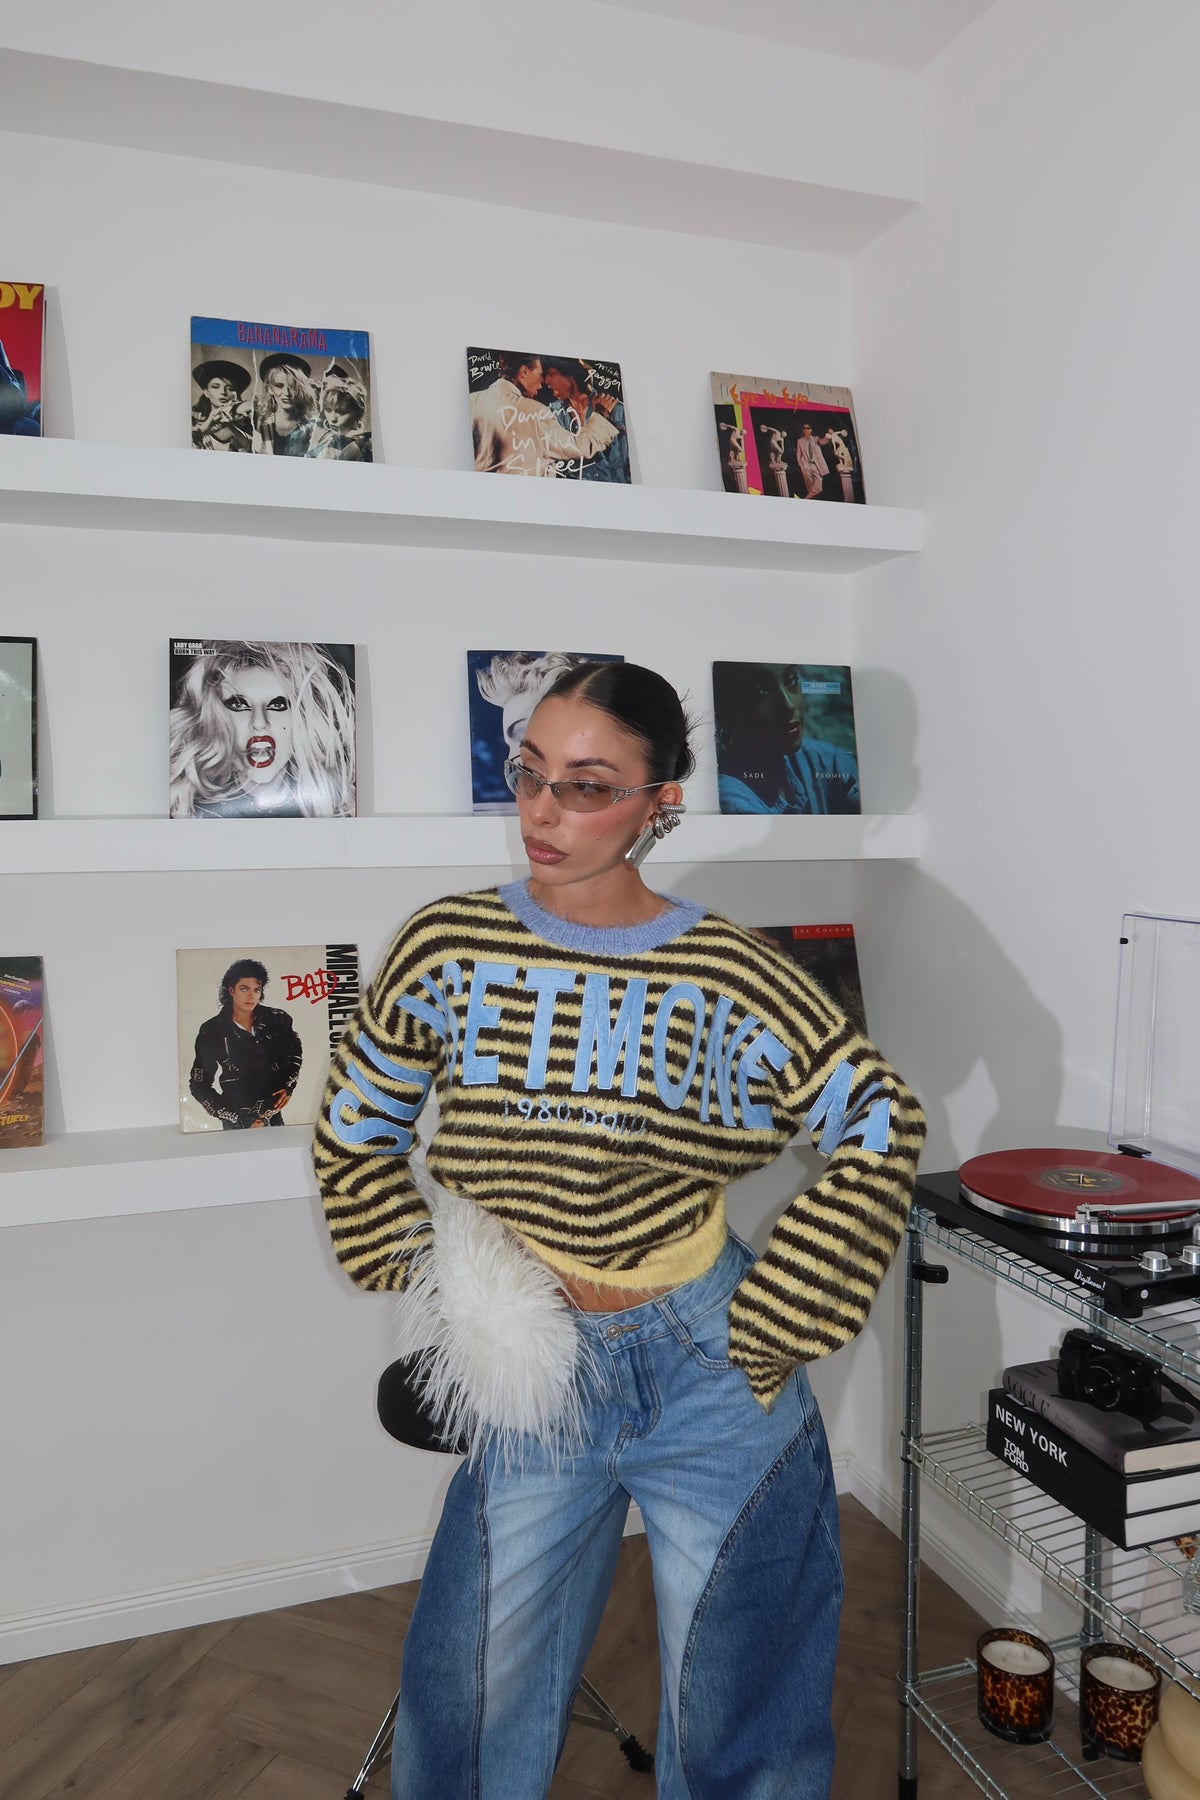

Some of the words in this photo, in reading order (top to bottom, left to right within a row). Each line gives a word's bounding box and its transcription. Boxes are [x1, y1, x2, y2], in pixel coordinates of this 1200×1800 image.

[237, 322, 327, 353] BANANARAMA
[468, 352, 492, 364] David
[469, 362, 501, 382] Bowie
[497, 405, 582, 437] Dancing
[511, 430, 535, 451] in
[541, 433, 582, 456] the
[280, 967, 338, 1005] BAD
[504, 1096, 571, 1124] 1980
[995, 1403, 1026, 1437] NEW
[1029, 1427, 1068, 1468] YORK
[1004, 1437, 1025, 1460] TOM
[1004, 1449, 1029, 1473] FORD
